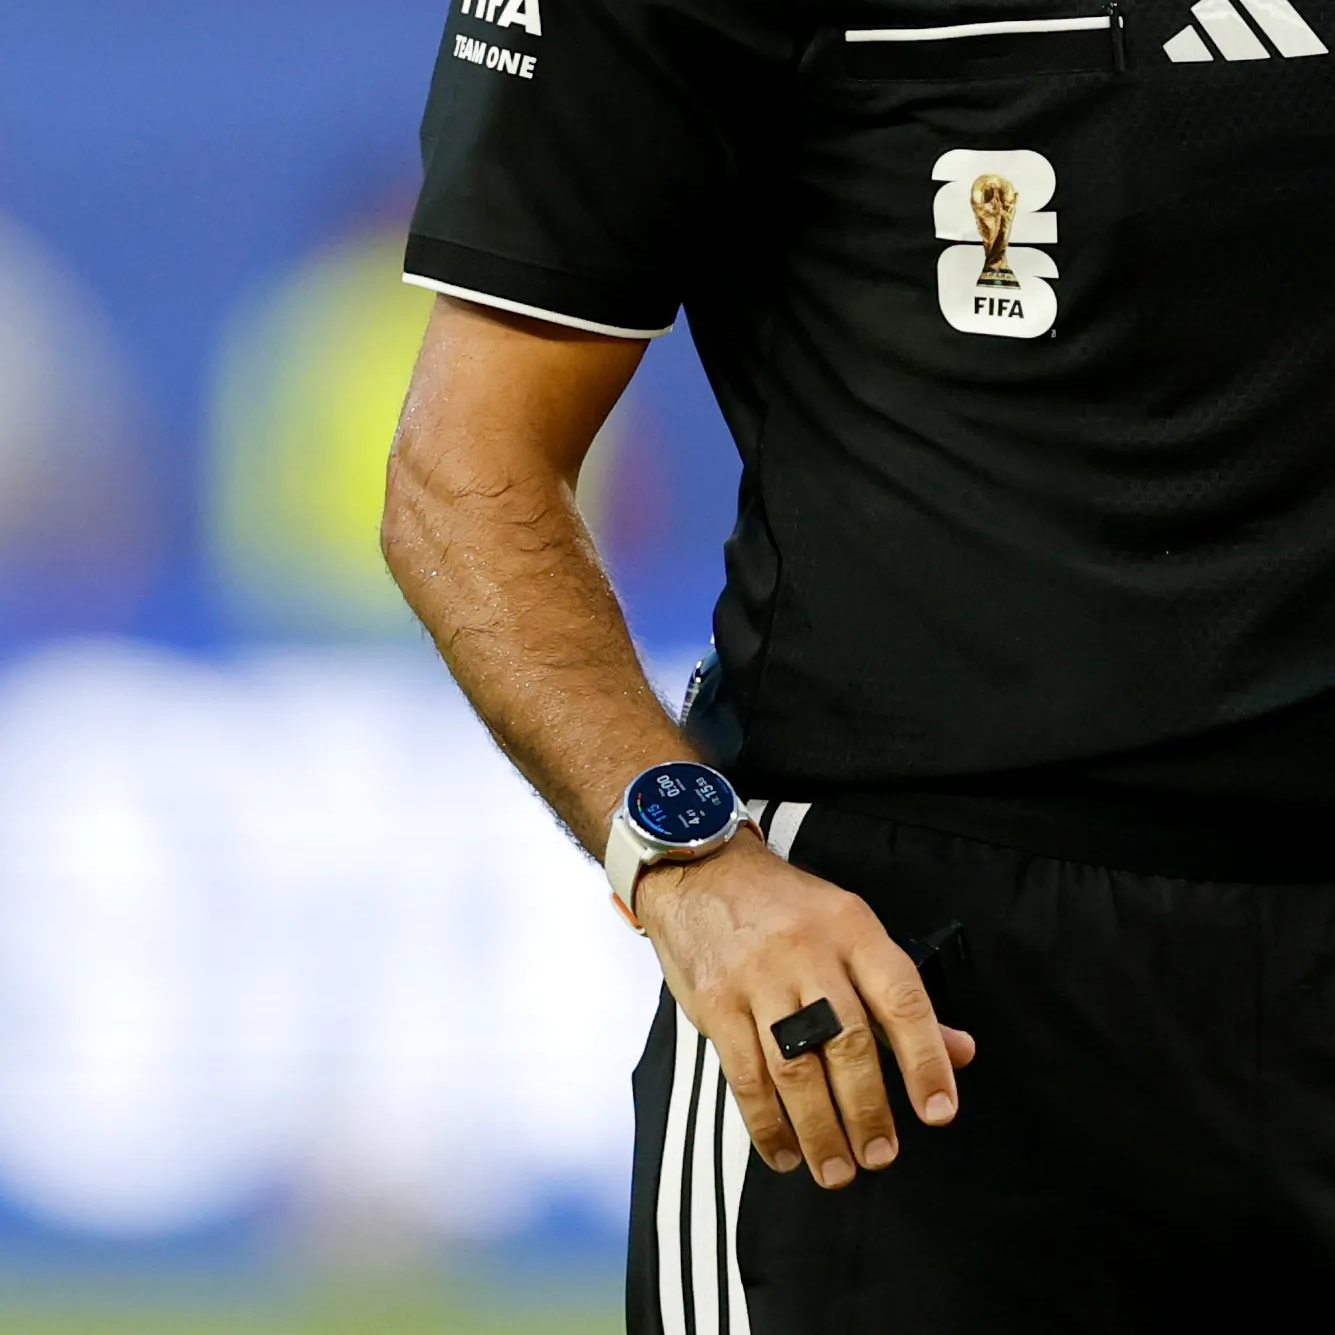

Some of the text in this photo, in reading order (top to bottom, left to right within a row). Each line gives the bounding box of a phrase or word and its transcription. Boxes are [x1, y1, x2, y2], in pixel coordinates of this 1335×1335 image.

[453, 33, 538, 80] TEAM ONE
[973, 295, 1026, 320] FIFA
